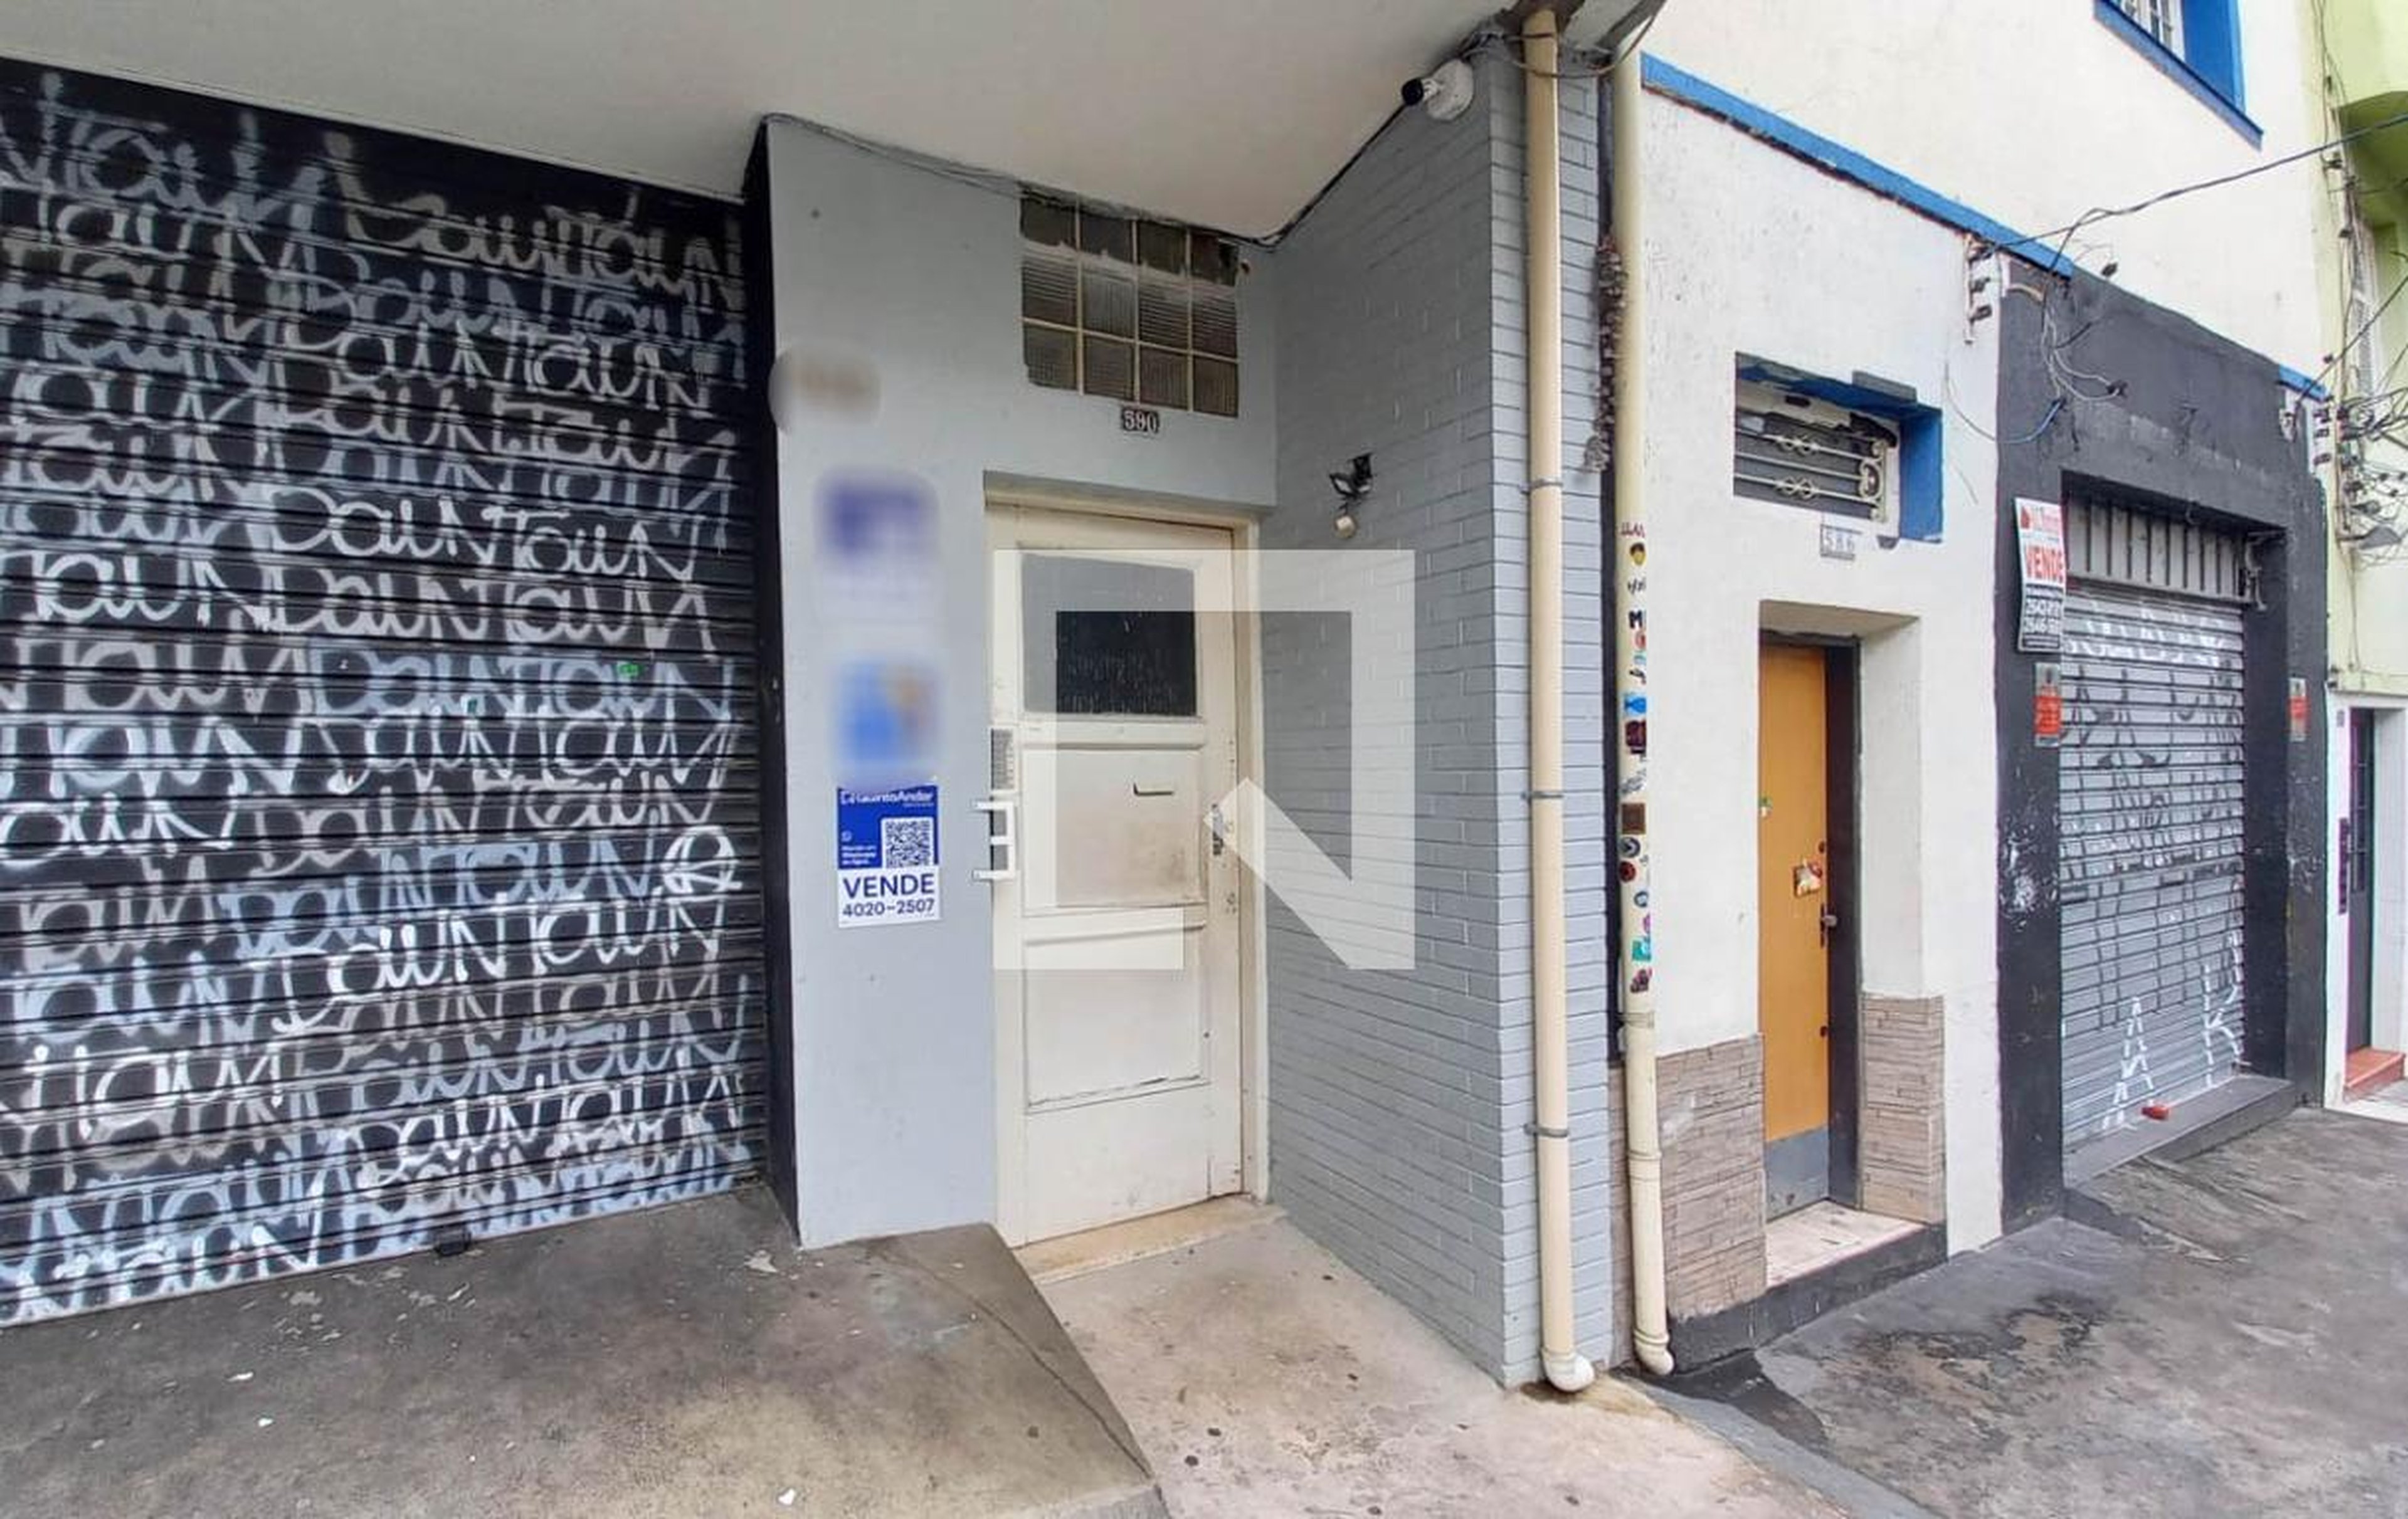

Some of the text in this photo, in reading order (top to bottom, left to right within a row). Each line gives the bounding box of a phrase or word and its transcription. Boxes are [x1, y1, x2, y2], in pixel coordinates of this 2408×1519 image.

[2025, 544, 2063, 584] VENDE
[843, 873, 935, 899] VENDE
[842, 898, 936, 918] 4020-2507
